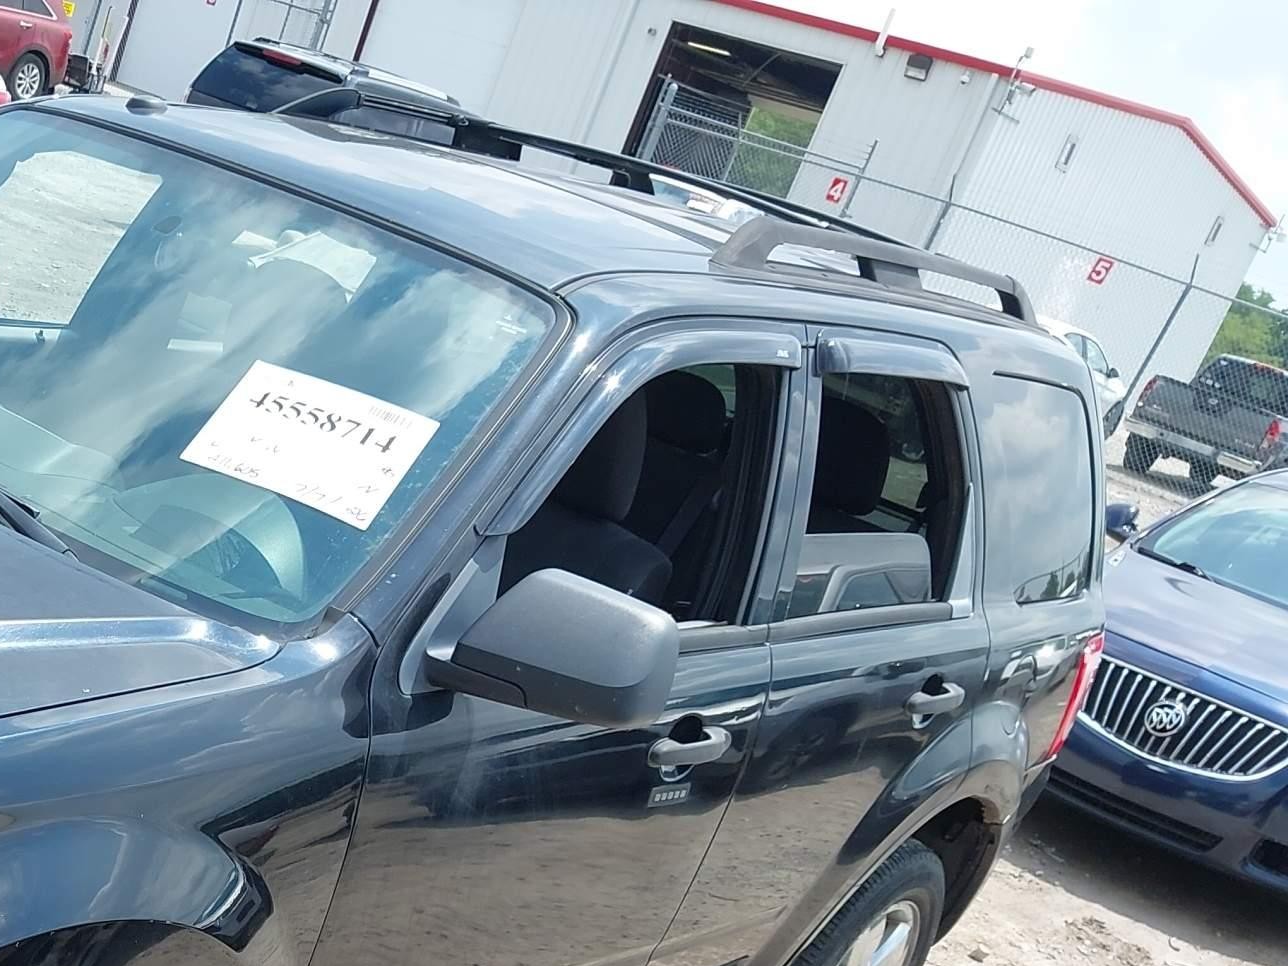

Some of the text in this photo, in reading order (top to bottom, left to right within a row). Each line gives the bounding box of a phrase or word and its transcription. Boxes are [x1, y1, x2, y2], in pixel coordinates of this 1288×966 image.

[829, 180, 845, 202] 4
[1092, 260, 1111, 281] 5
[249, 392, 398, 454] 45558714
